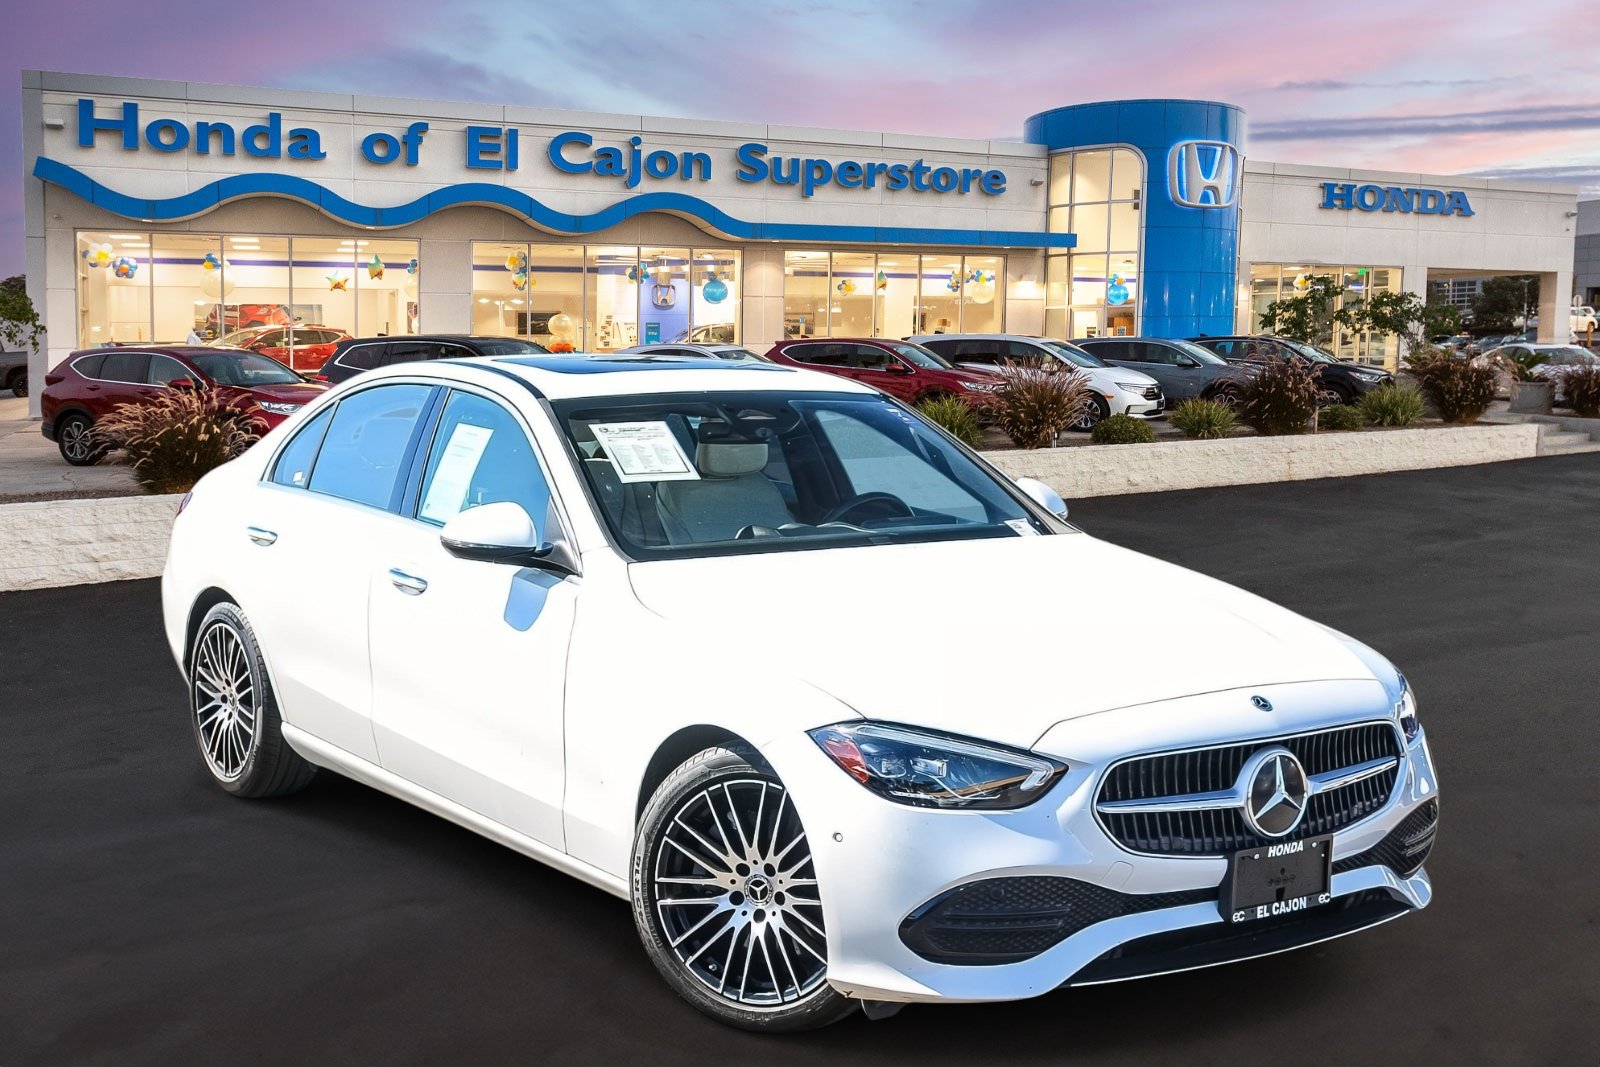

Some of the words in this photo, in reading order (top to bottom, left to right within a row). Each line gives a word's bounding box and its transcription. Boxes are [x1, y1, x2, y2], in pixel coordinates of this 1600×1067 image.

[78, 98, 326, 161] Honda
[361, 122, 429, 166] of
[466, 126, 519, 172] El
[548, 130, 711, 190] Cajon
[736, 143, 1007, 198] Superstore
[1319, 182, 1475, 216] HONDA
[1267, 840, 1304, 858] HONDA
[1256, 905, 1270, 919] EL
[1272, 896, 1307, 915] CAJON
